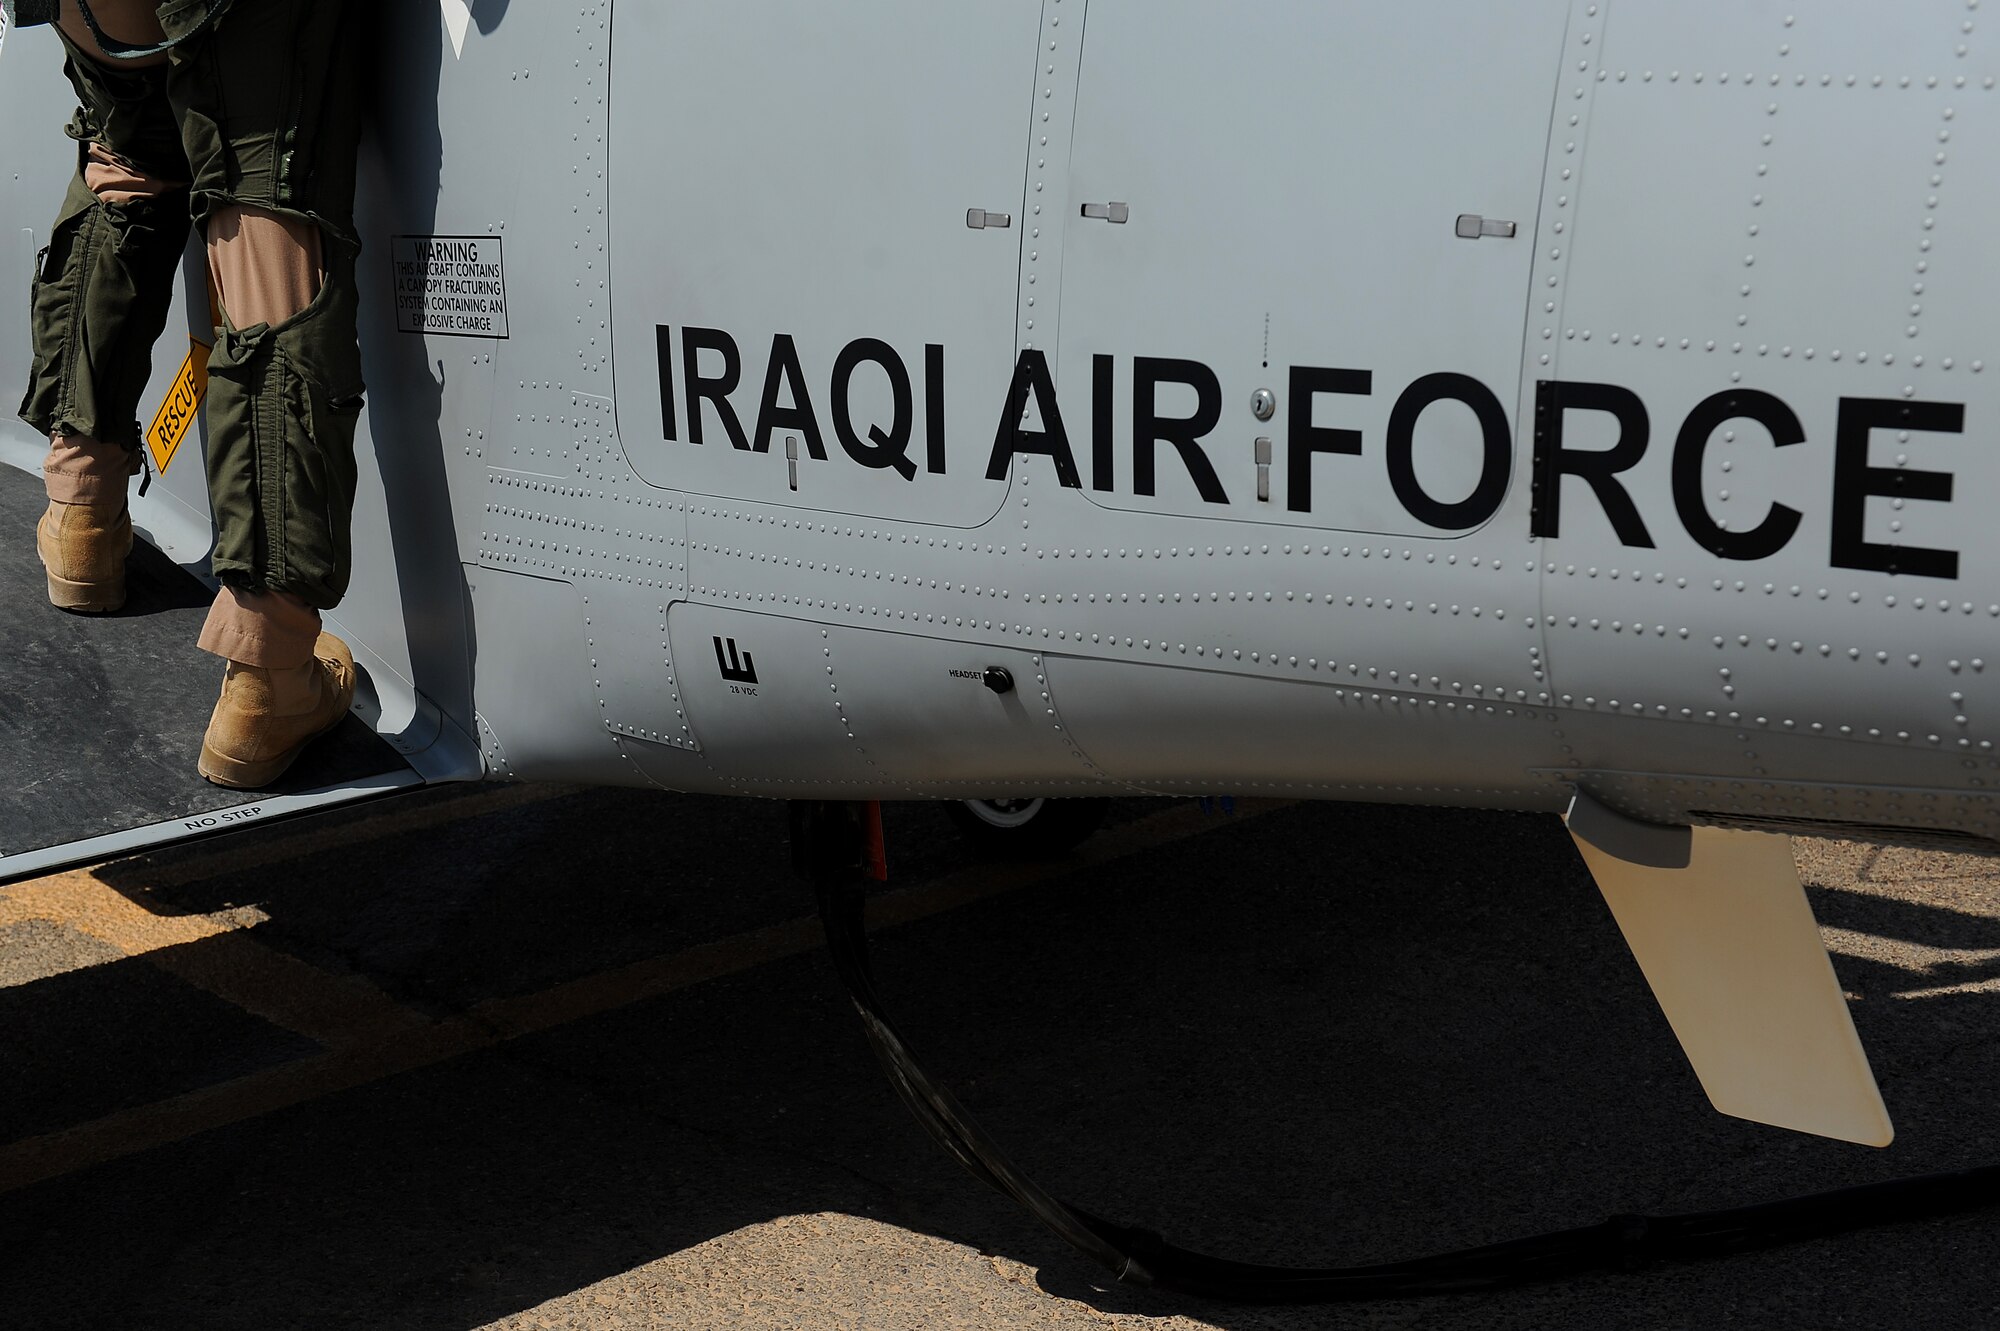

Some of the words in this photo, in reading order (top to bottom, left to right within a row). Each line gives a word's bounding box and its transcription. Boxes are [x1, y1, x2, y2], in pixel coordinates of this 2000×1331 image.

[414, 242, 478, 262] WARNING
[396, 261, 414, 275] THIS
[416, 262, 453, 276] AIRCRAFT
[456, 263, 500, 278] CONTAINS
[398, 279, 405, 291] A
[407, 279, 442, 292] CANOPY
[445, 280, 501, 295] FRACTURING
[400, 295, 429, 309] SYSTEM
[431, 297, 487, 312] CONTAINING
[489, 300, 503, 313] AN
[412, 314, 453, 328] EXPLOSIVE
[456, 316, 491, 330] CHARGE
[157, 370, 199, 450] RESCUE
[655, 323, 947, 482] IRAQI
[985, 348, 1230, 505] AIR
[1287, 366, 1966, 580] FORCE
[948, 669, 982, 680] HEADSET
[729, 685, 740, 694] 28
[740, 686, 758, 697] VDC
[184, 817, 217, 830] NO
[221, 807, 262, 822] STEP
